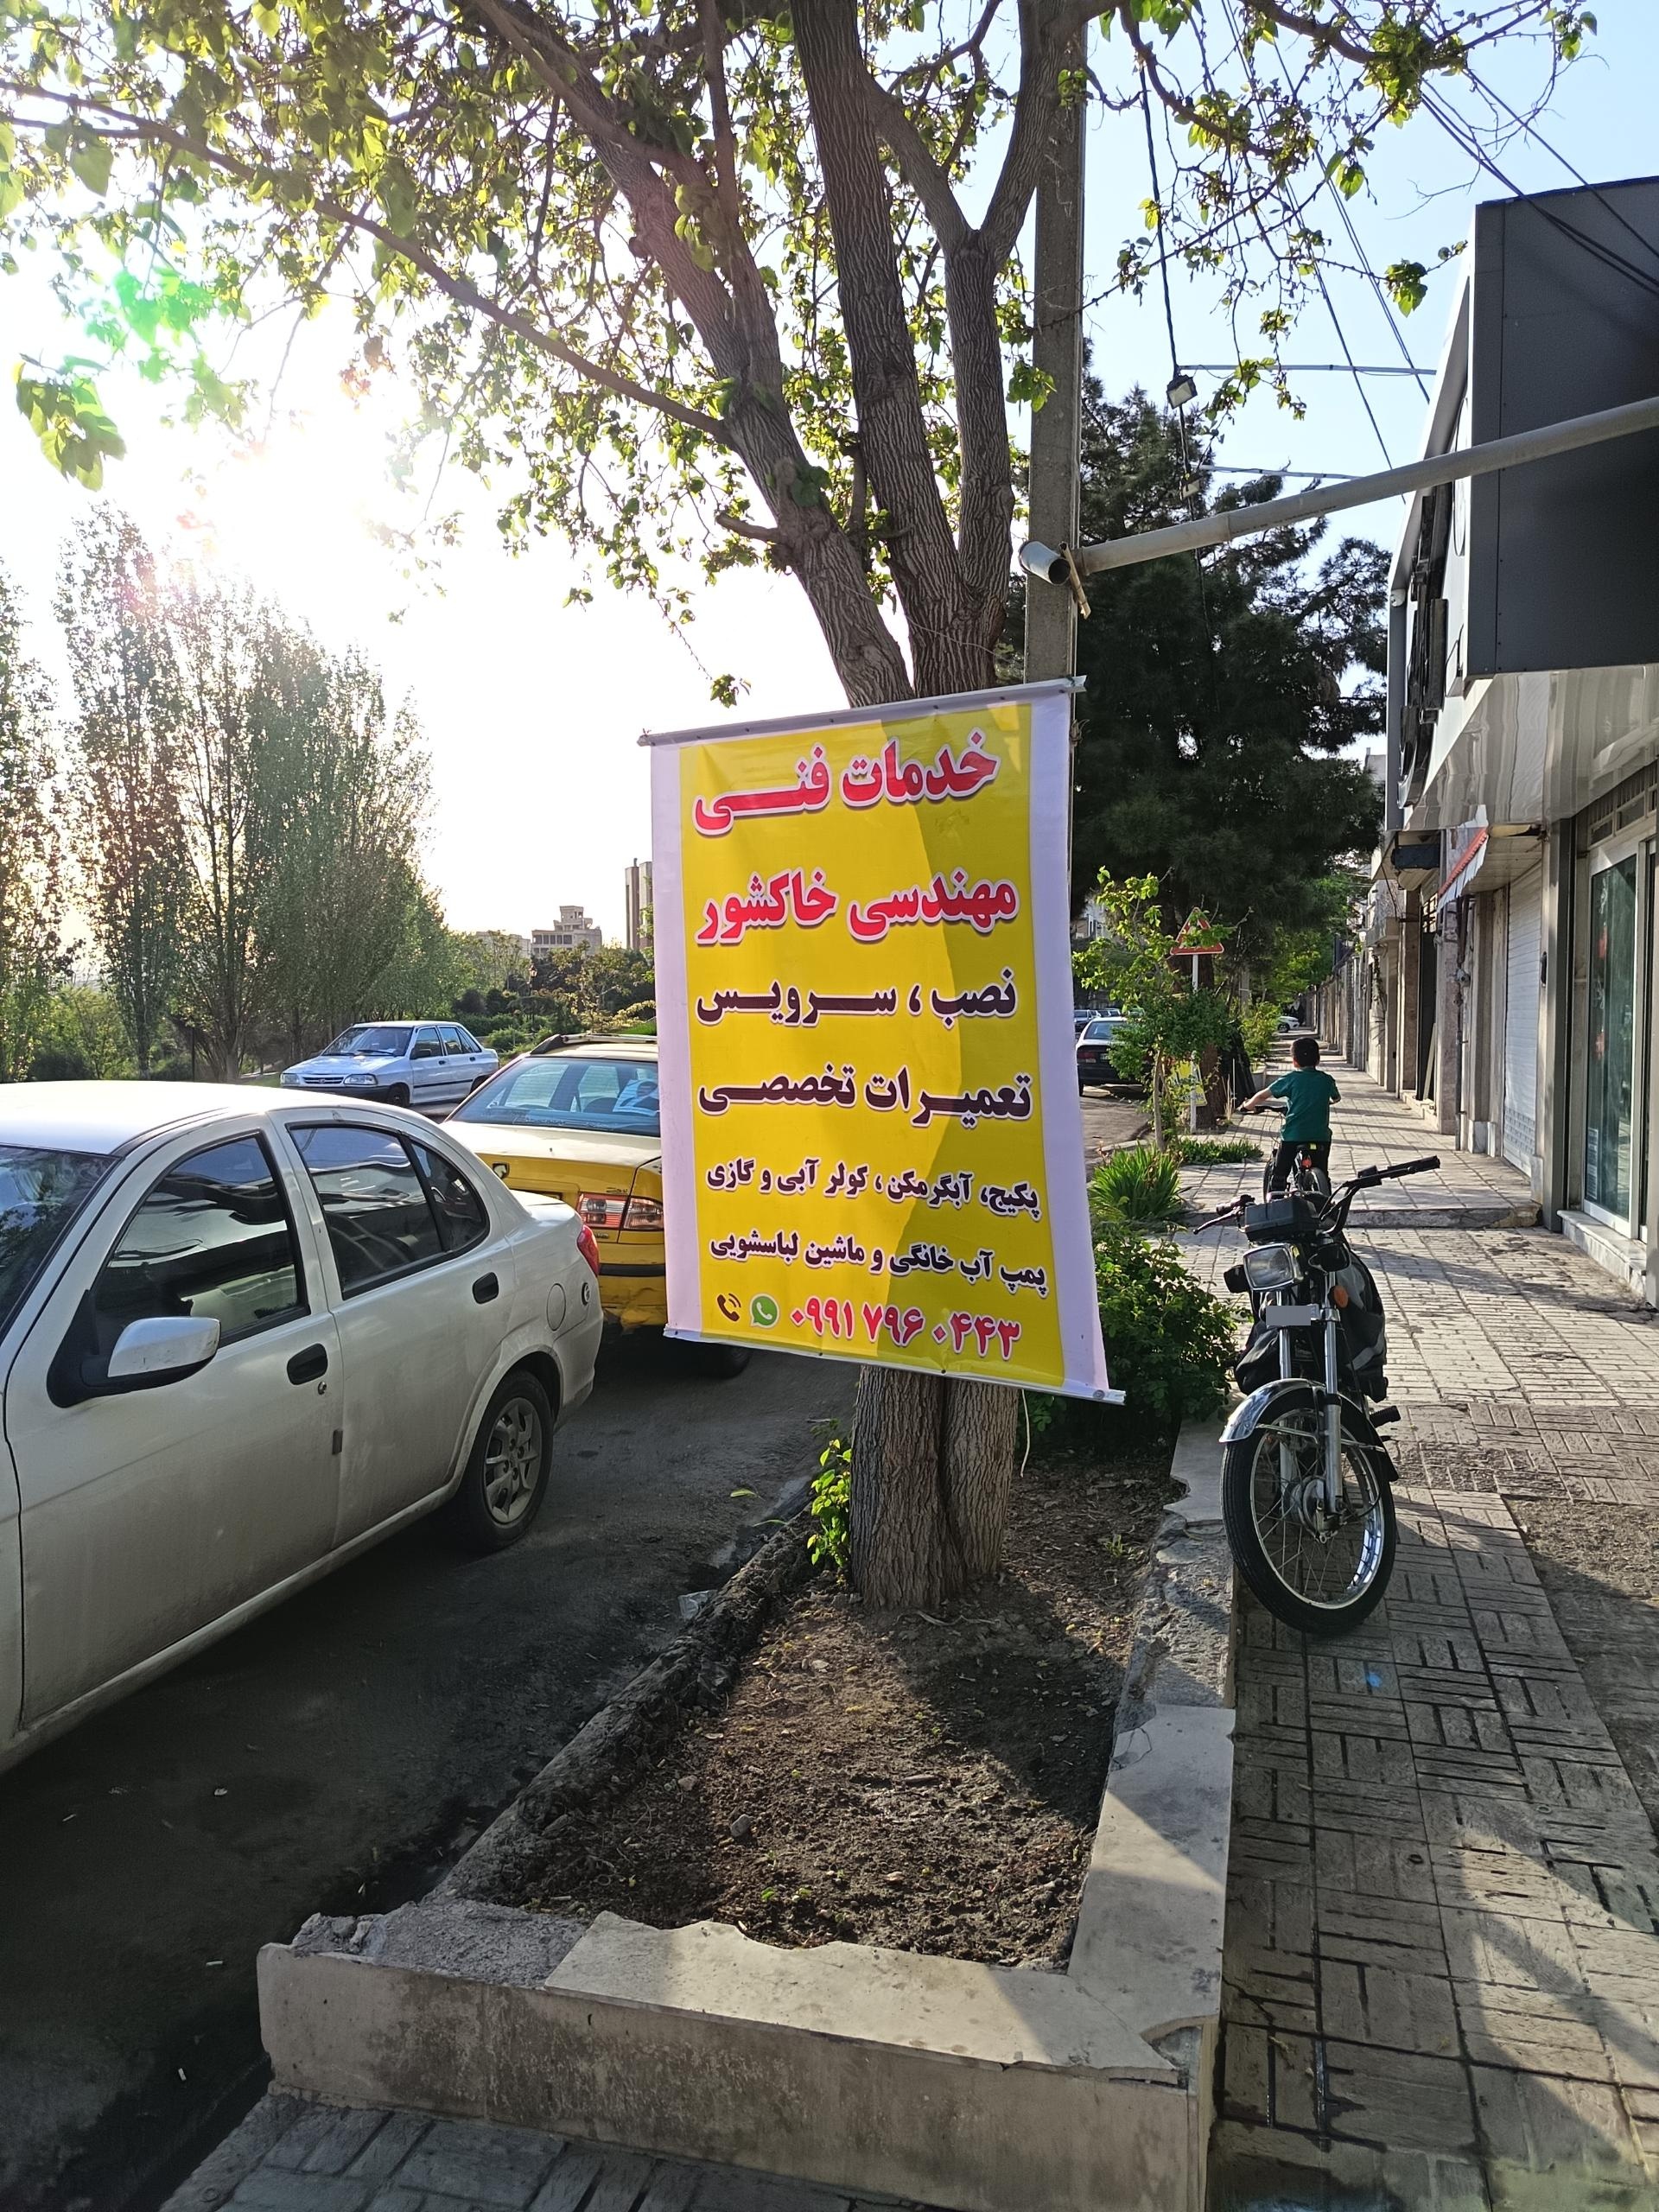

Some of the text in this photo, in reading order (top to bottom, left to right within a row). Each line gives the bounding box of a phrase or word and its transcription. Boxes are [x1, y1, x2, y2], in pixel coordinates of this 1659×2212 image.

[693, 730, 998, 833] خدمات فنی
[696, 869, 1019, 943] مهندسی خاکشور
[696, 980, 898, 1025] سرویس
[698, 1063, 1033, 1127] تعمیرات تخصصی
[706, 1157, 756, 1189] گازی
[760, 1168, 772, 1192] و
[776, 1158, 820, 1192] آبی
[824, 1161, 869, 1196] کولر
[709, 1230, 1048, 1296] پمپ آب خانگی و ماشین لباسشویی
